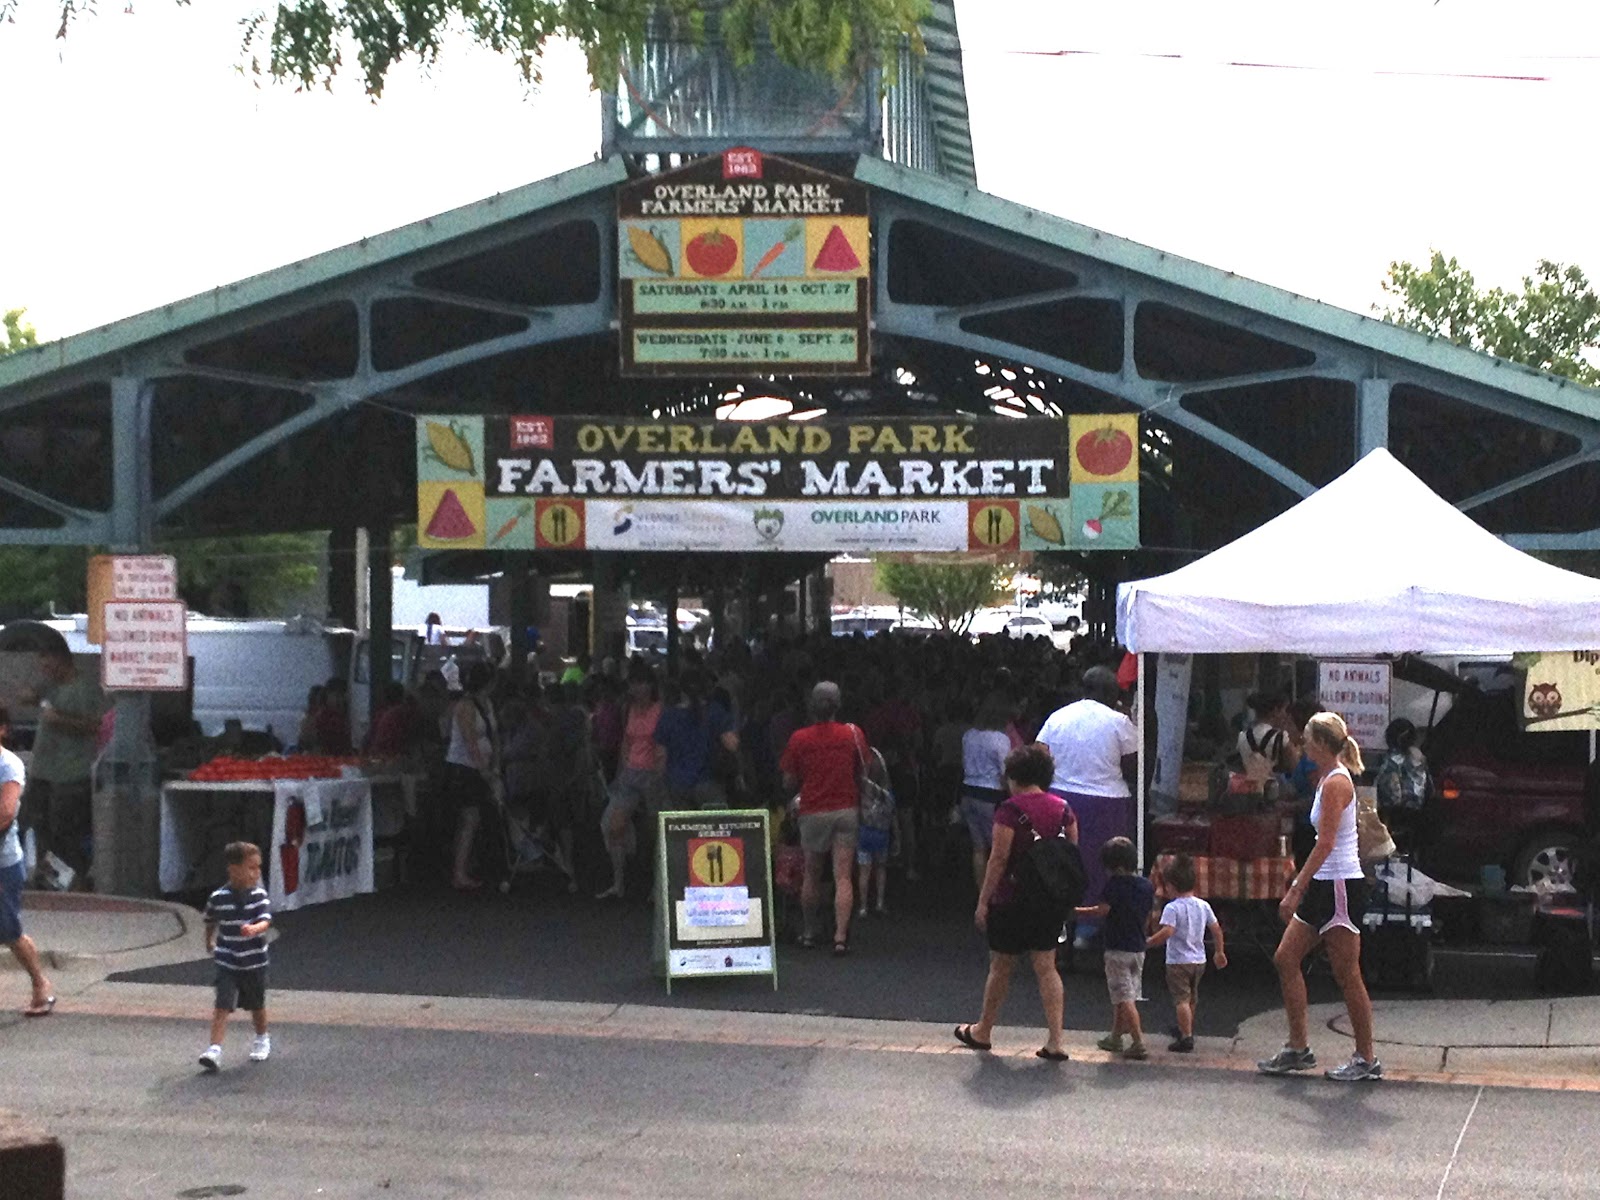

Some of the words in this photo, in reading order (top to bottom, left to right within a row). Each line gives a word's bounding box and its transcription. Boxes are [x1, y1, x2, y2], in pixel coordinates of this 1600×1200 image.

[654, 184, 767, 199] OVERLAND
[774, 184, 830, 199] PARK
[641, 200, 746, 214] FARMERS'
[753, 199, 844, 213] MARKET
[639, 284, 717, 296] SATURDAYS
[728, 284, 769, 295] APRIL
[774, 284, 788, 295] 14
[834, 284, 850, 294] 27
[637, 334, 727, 345] WEDNESDAYS
[737, 333, 772, 345] JUNE
[577, 425, 832, 454] OVERLAND
[848, 425, 976, 454] PARK
[497, 458, 782, 496] FARMERS'
[800, 459, 1055, 496] MARKET
[1344, 669, 1381, 683] ANIMALS
